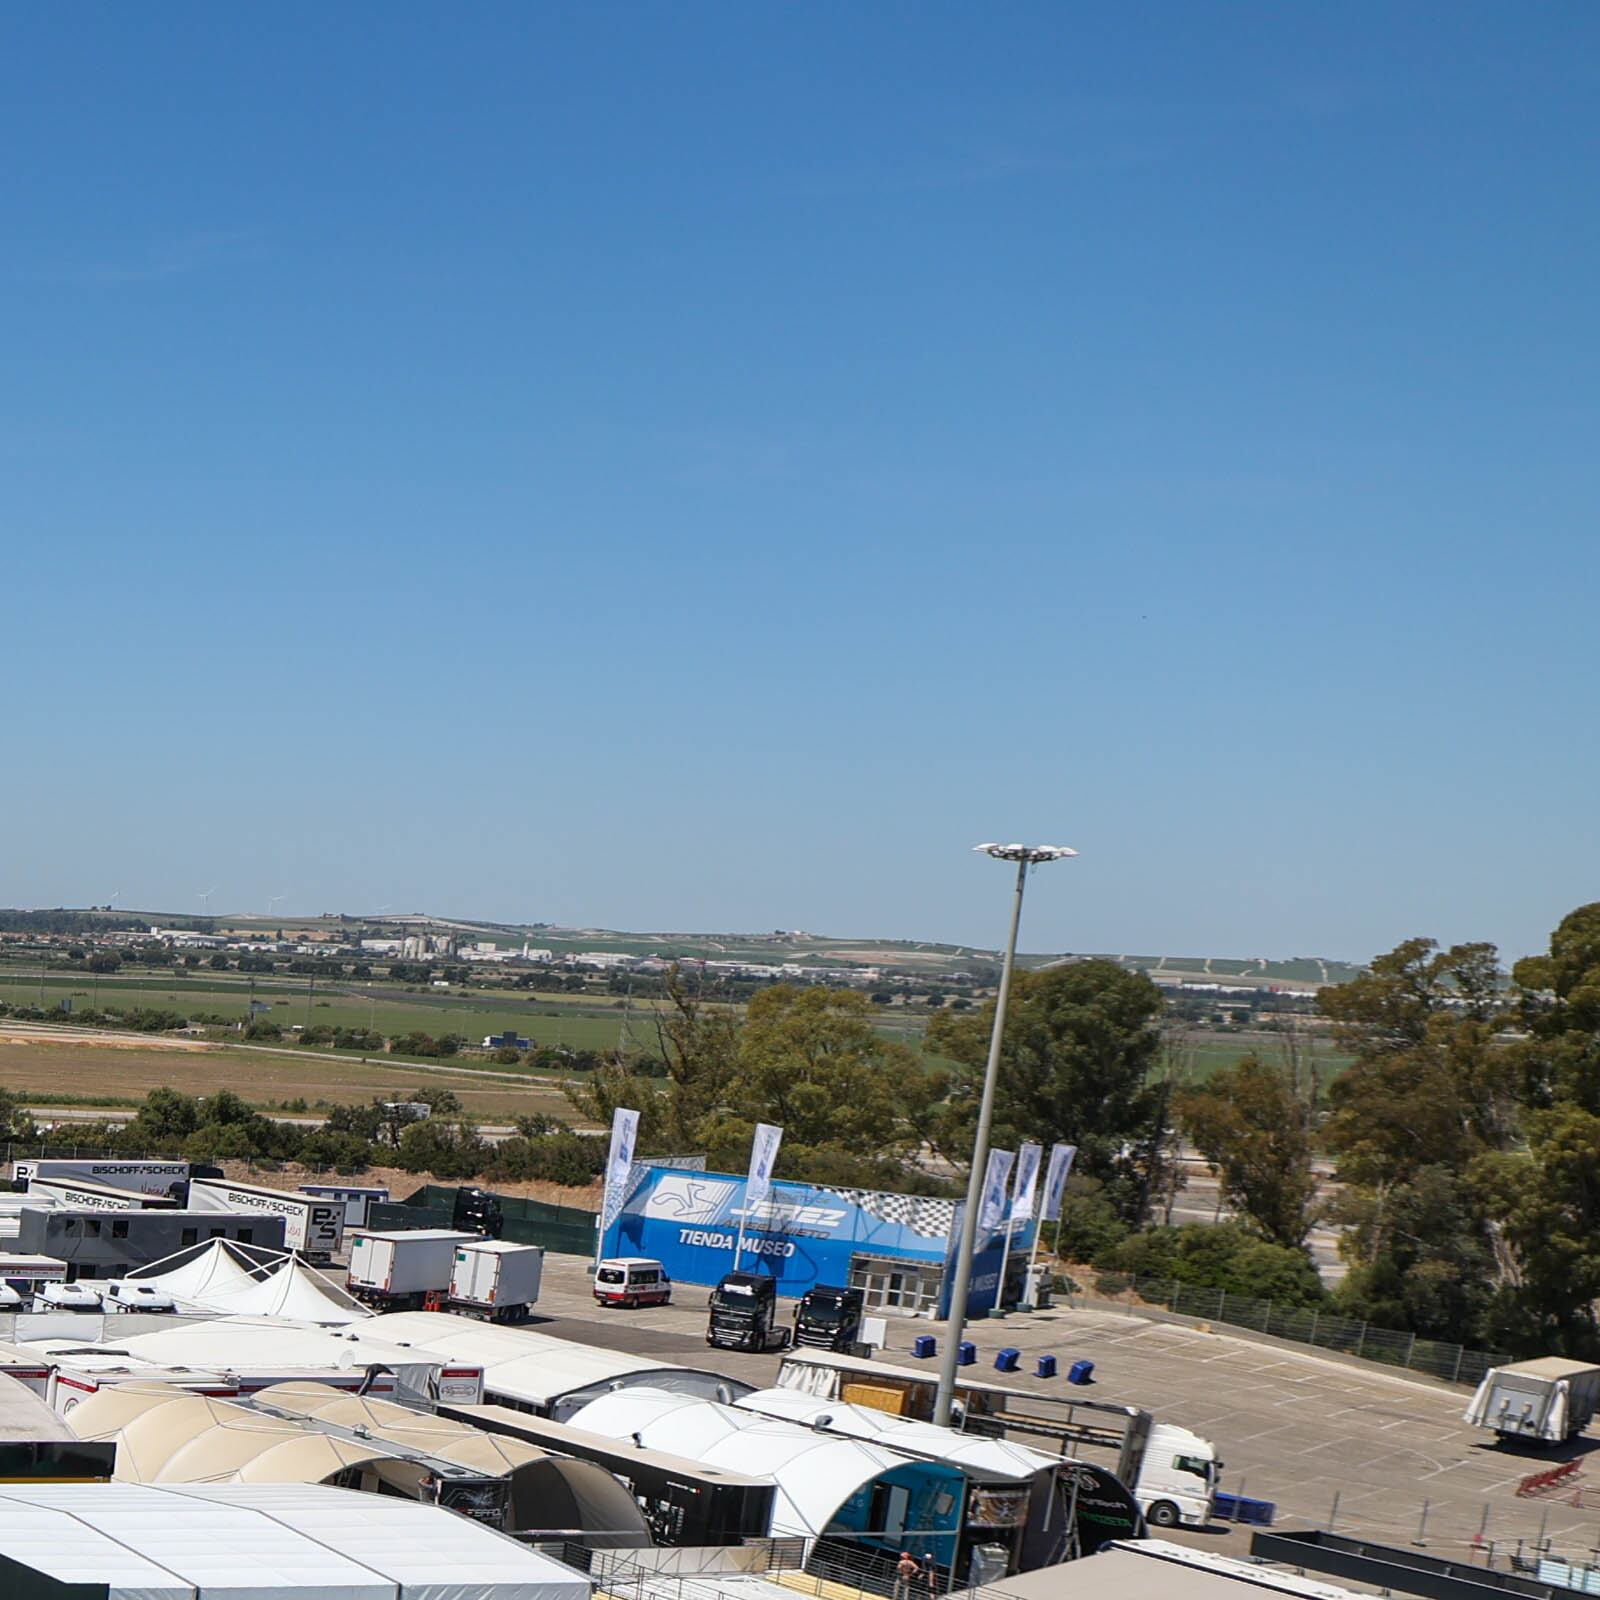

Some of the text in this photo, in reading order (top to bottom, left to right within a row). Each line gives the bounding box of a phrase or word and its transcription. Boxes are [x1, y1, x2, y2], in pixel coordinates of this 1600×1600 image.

[92, 1165, 185, 1175] BISCHOFF SCHECK
[228, 1192, 304, 1217] BISCHOFF SCHECK
[729, 1201, 848, 1227] JEREZ
[680, 1228, 795, 1257] TIENDA MUSEO
